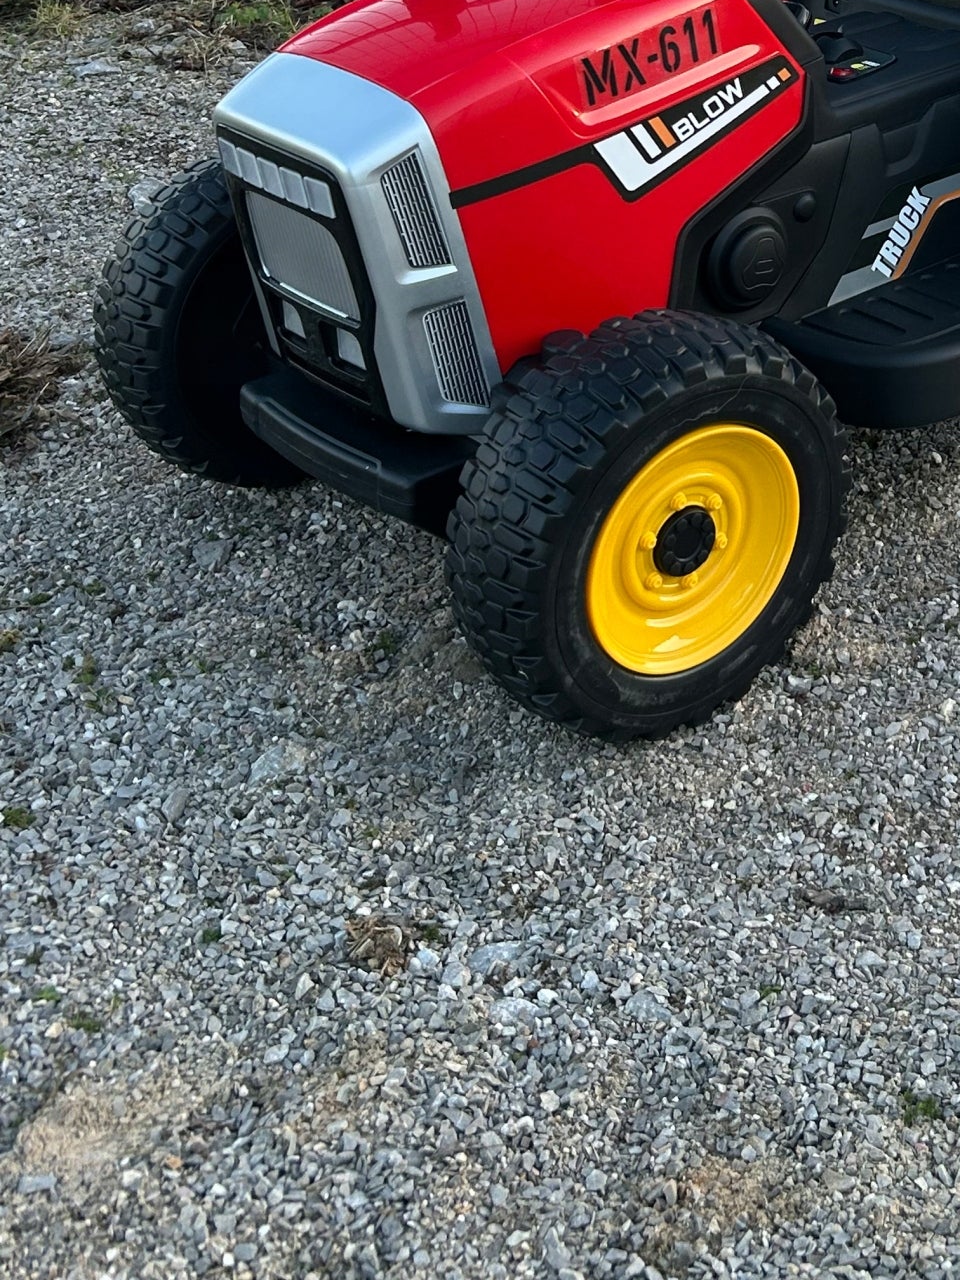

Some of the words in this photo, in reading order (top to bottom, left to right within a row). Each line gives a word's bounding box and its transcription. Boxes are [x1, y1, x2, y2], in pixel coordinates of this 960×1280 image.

[581, 9, 719, 106] MX-611
[673, 78, 745, 142] BLOW
[870, 185, 932, 279] TRUCK
